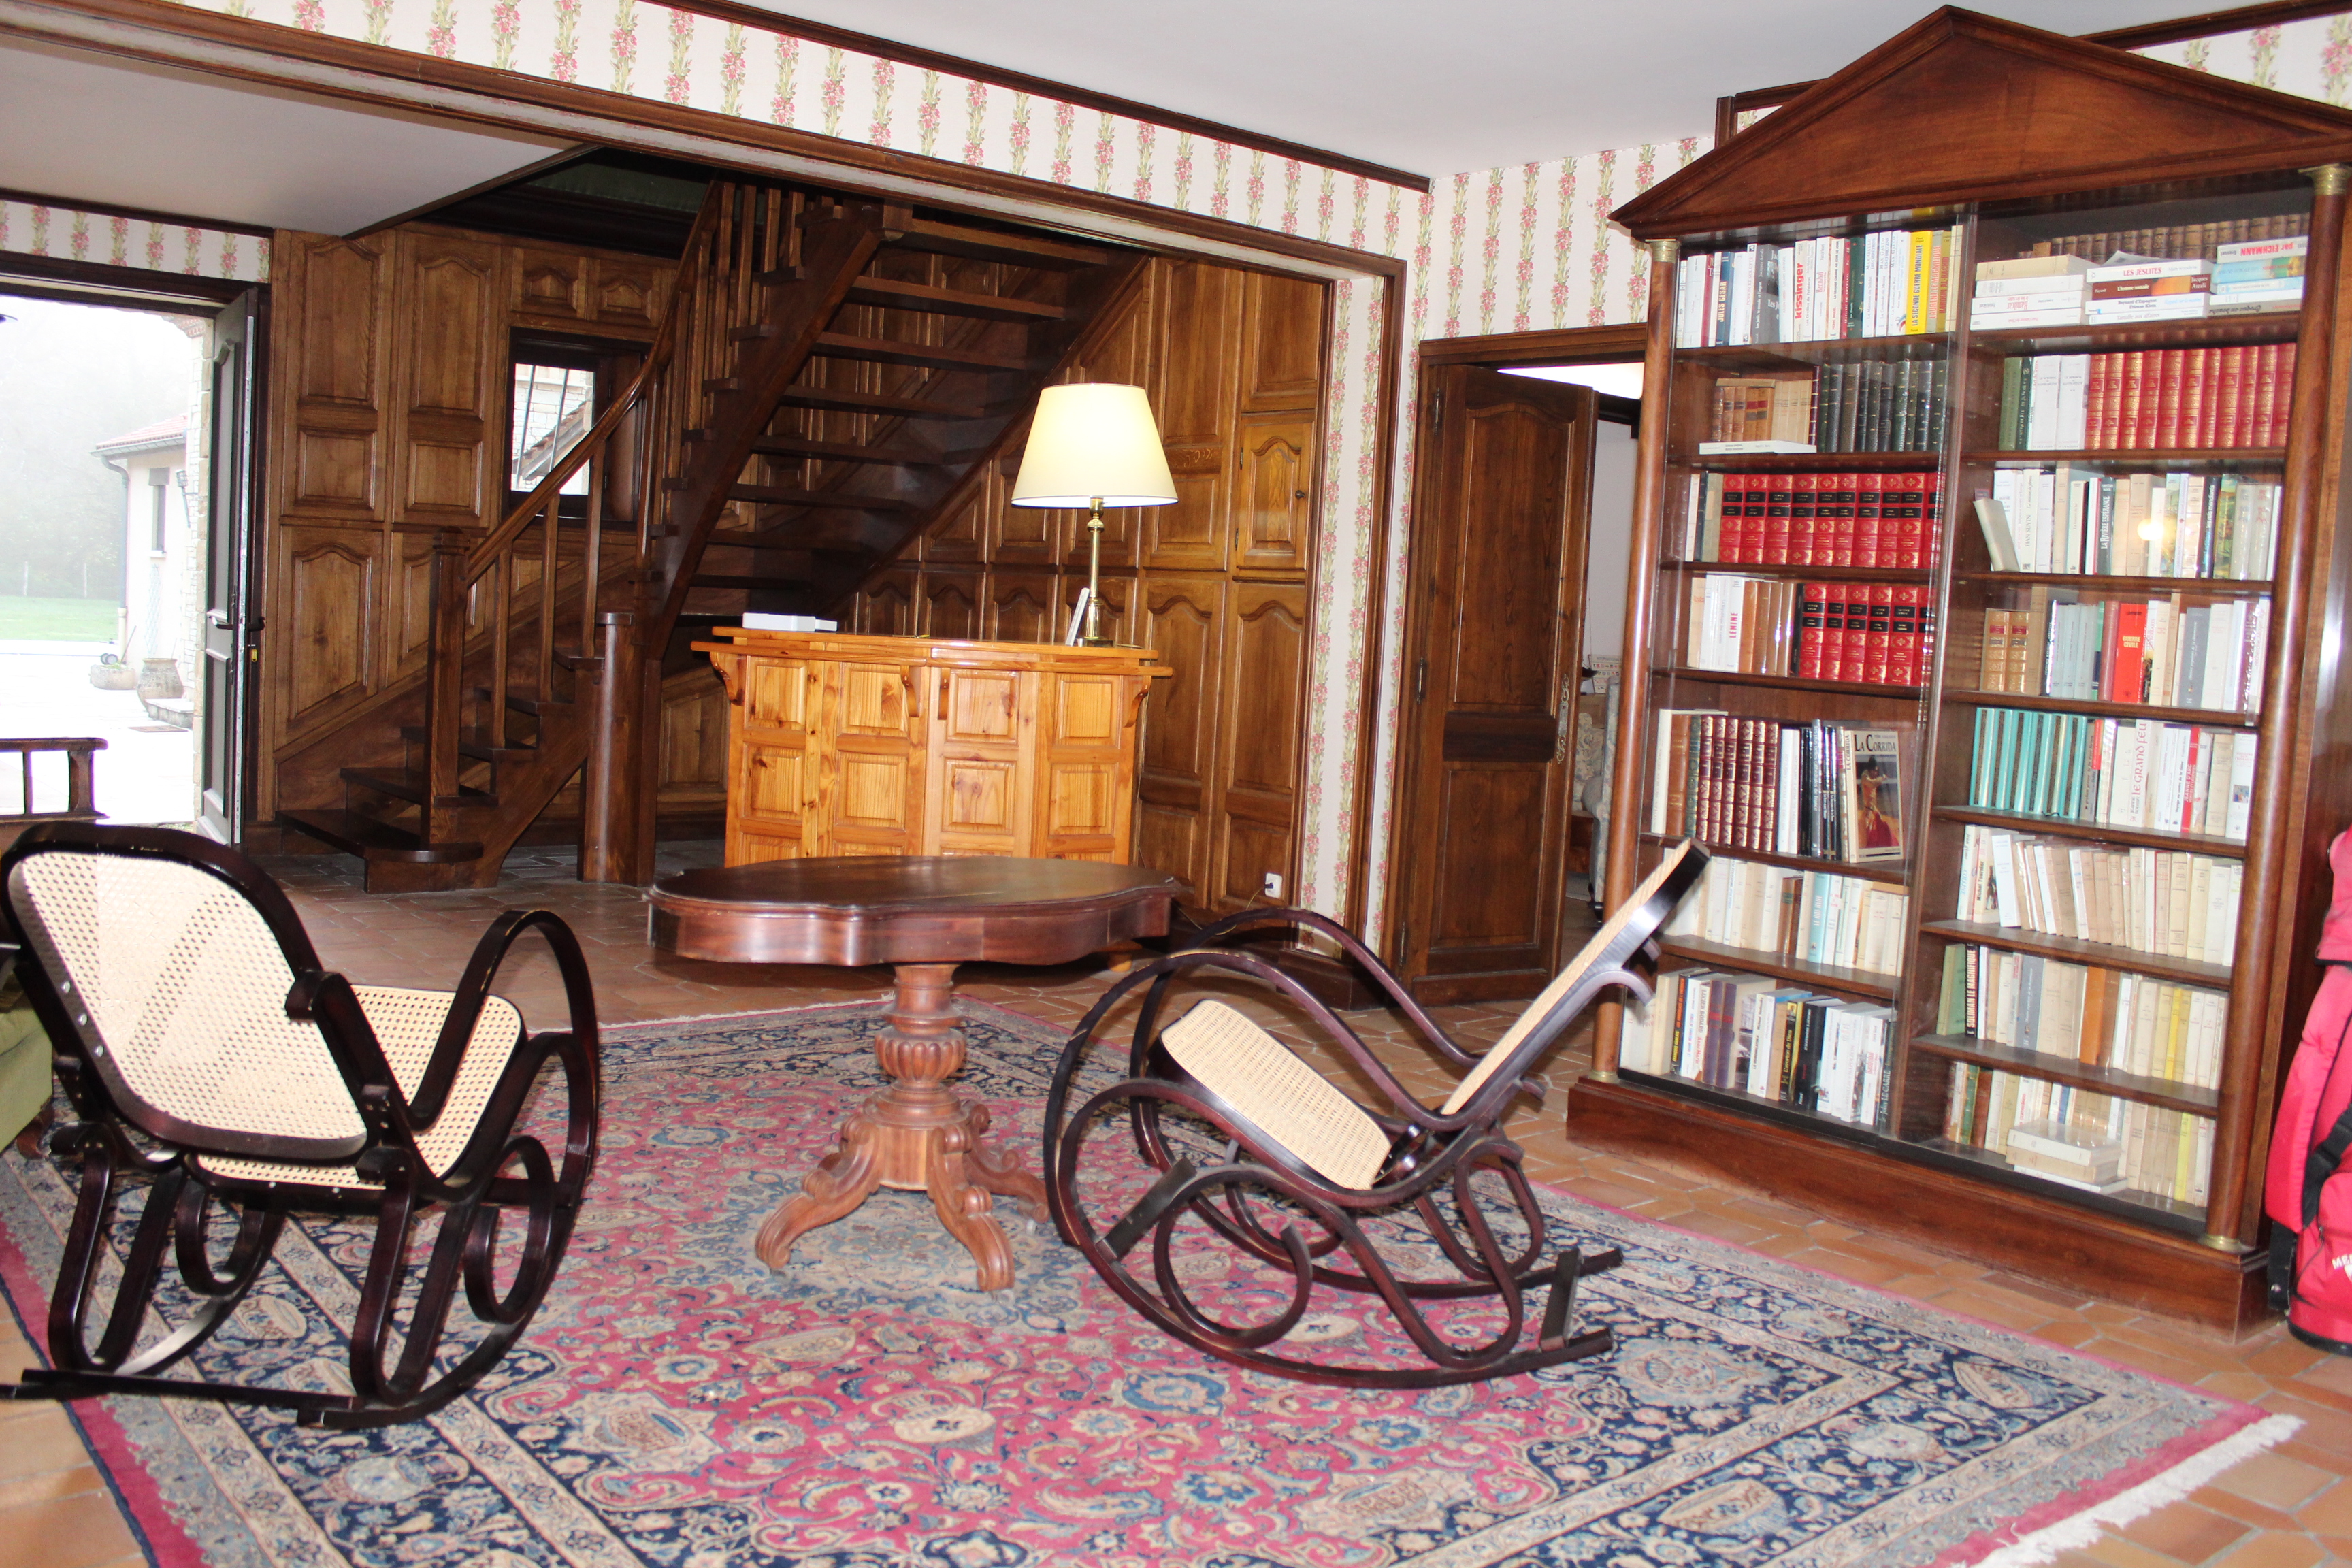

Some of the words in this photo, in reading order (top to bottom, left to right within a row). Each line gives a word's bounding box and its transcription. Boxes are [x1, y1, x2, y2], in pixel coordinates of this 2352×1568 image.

[1914, 245, 1923, 272] MONDIALE
[2240, 244, 2279, 256] EICHMANN
[1932, 246, 1941, 283] MAGNIFIQUE
[2136, 267, 2162, 276] JÉSUITES
[1795, 263, 1804, 319] kissinger
[1816, 272, 1824, 293] Hannibal
[1929, 292, 1938, 318] LAURENT
[1939, 289, 1947, 314] HAROUN
[2100, 495, 2110, 522] ESPÉRANCE
[1729, 612, 1738, 638] LÉNINE
[2123, 636, 2141, 644] GUERRE
[1855, 734, 1865, 752] LA
[1866, 734, 1896, 752] CORRIDA
[2136, 723, 2147, 744] FEU
[1846, 762, 1852, 770] LA
[2133, 745, 2144, 783] GRAND
[1813, 909, 1821, 919] ROI
[1967, 949, 1976, 990] MAGNIFIQUE
[1967, 998, 1976, 1028] SOLIMAN
[1881, 1093, 1889, 1101] LE
